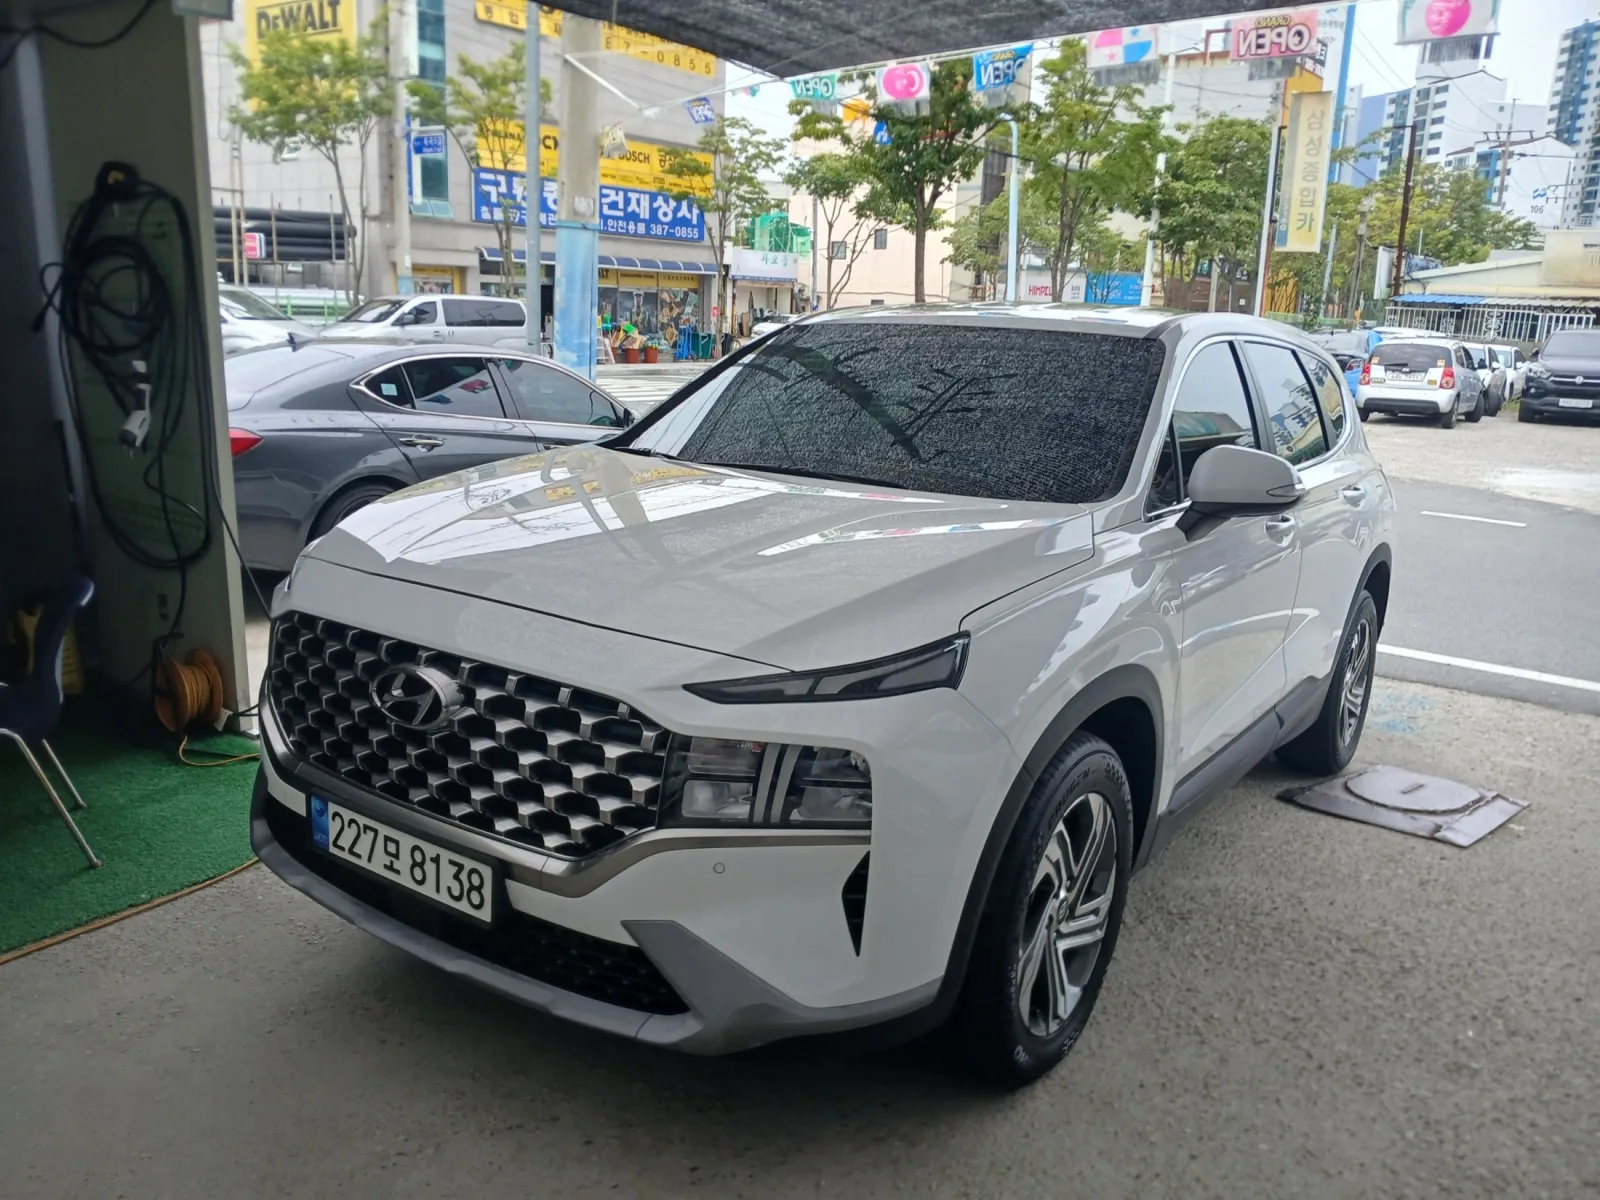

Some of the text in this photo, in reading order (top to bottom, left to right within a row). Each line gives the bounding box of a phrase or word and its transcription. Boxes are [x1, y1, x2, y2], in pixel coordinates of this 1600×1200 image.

[1296, 108, 1327, 233] 삼성종합카
[649, 223, 699, 239] 387-0855
[1530, 205, 1545, 214] 106
[331, 810, 485, 911] 227모 8138
